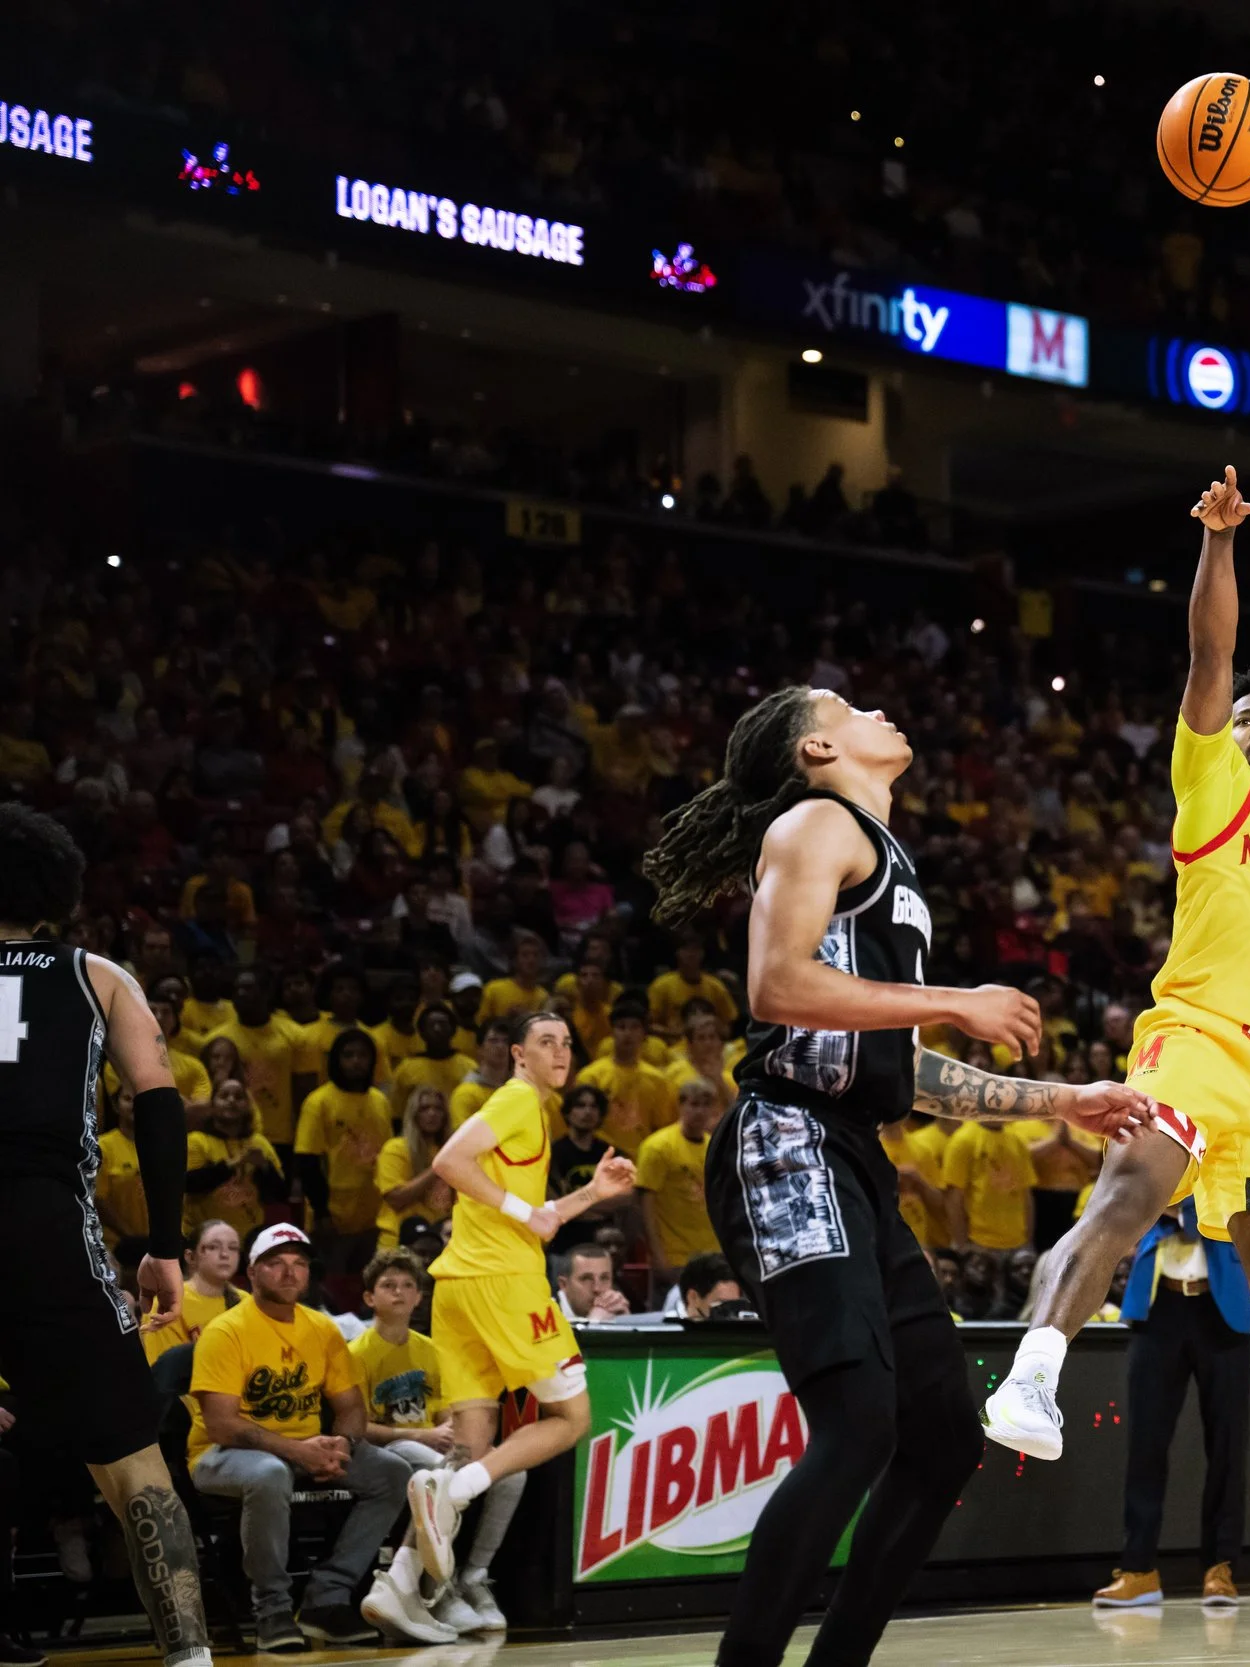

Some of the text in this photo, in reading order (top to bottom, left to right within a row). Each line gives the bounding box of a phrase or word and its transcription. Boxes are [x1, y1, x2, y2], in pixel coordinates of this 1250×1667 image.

[1198, 78, 1241, 152] Wilson
[336, 175, 584, 267] LOGAN'S SAUSAGE
[803, 272, 949, 352] xfinity
[1031, 309, 1067, 369] M
[528, 1305, 559, 1341] M
[579, 1391, 806, 1574] LIBMA
[129, 1495, 185, 1644] GODSPEED
